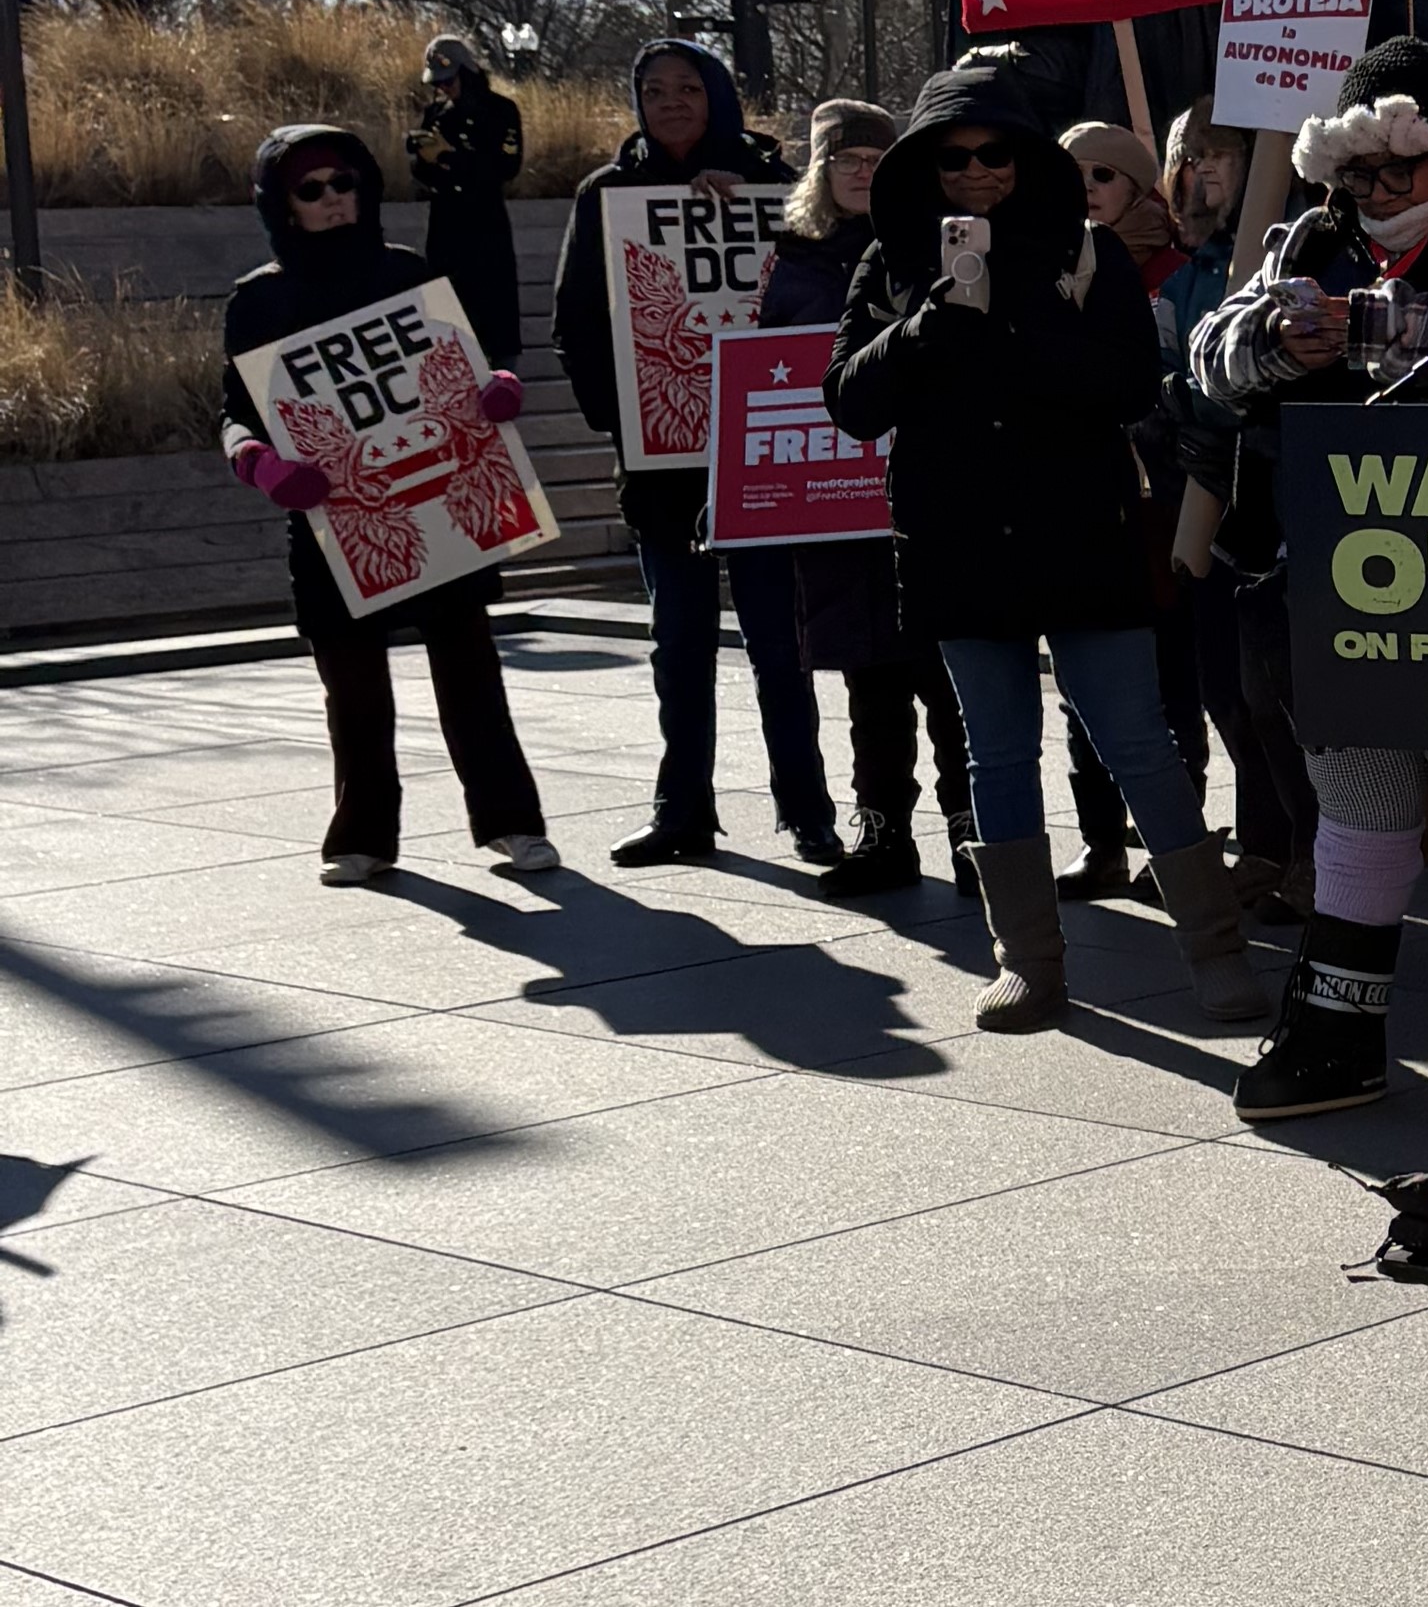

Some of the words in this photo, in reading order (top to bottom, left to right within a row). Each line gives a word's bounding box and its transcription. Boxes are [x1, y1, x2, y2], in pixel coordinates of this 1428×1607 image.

[1282, 26, 1296, 39] la
[1256, 72, 1275, 85] de
[1279, 71, 1308, 91] DC
[647, 197, 784, 245] FREE
[684, 246, 758, 293] DC
[281, 305, 433, 399] FREE
[336, 366, 419, 431] DC
[1333, 631, 1398, 660] ON
